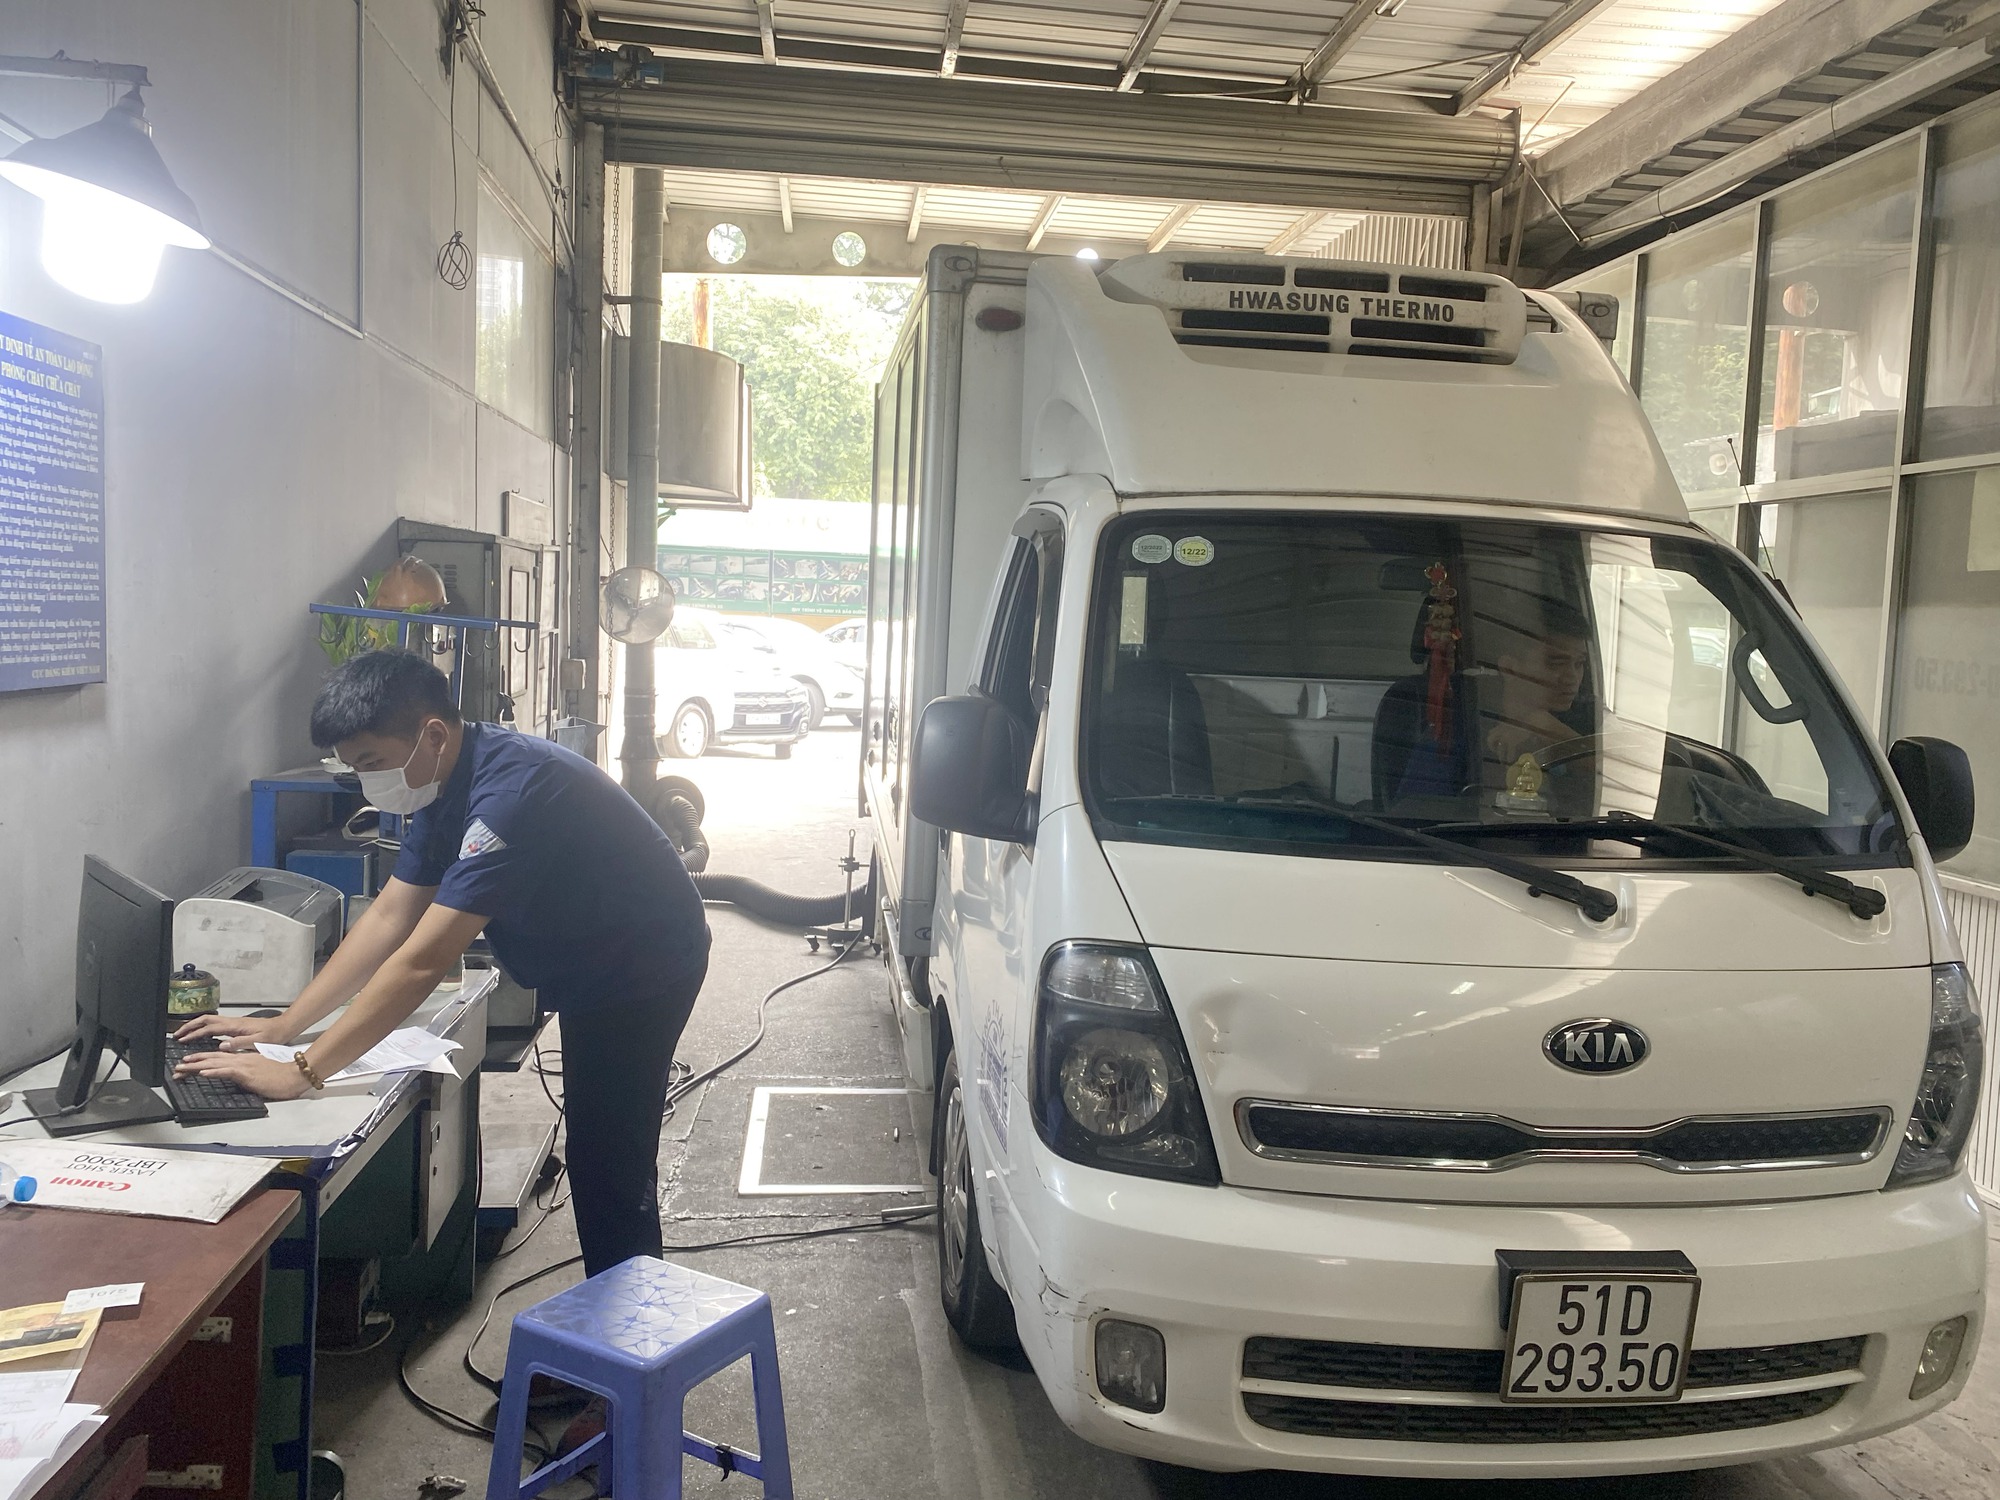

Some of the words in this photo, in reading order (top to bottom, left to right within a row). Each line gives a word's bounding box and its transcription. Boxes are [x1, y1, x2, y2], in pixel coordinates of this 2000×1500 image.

[1229, 290, 1349, 314] HWASUNG
[1361, 297, 1455, 323] THERMO
[34, 345, 45, 363] AN
[45, 347, 62, 369] TOÀN
[1, 356, 25, 382] PHÒNG
[26, 364, 44, 388] CHÁY
[1181, 548, 1206, 556] 12/22
[1563, 1031, 1634, 1063] KIA
[63, 1162, 108, 1174] SHOT
[74, 1154, 168, 1171] LBP2900
[109, 1166, 157, 1177] LASER
[50, 1176, 131, 1192] Canon
[1557, 1284, 1652, 1336] 51D
[1510, 1342, 1680, 1395] 293.50
